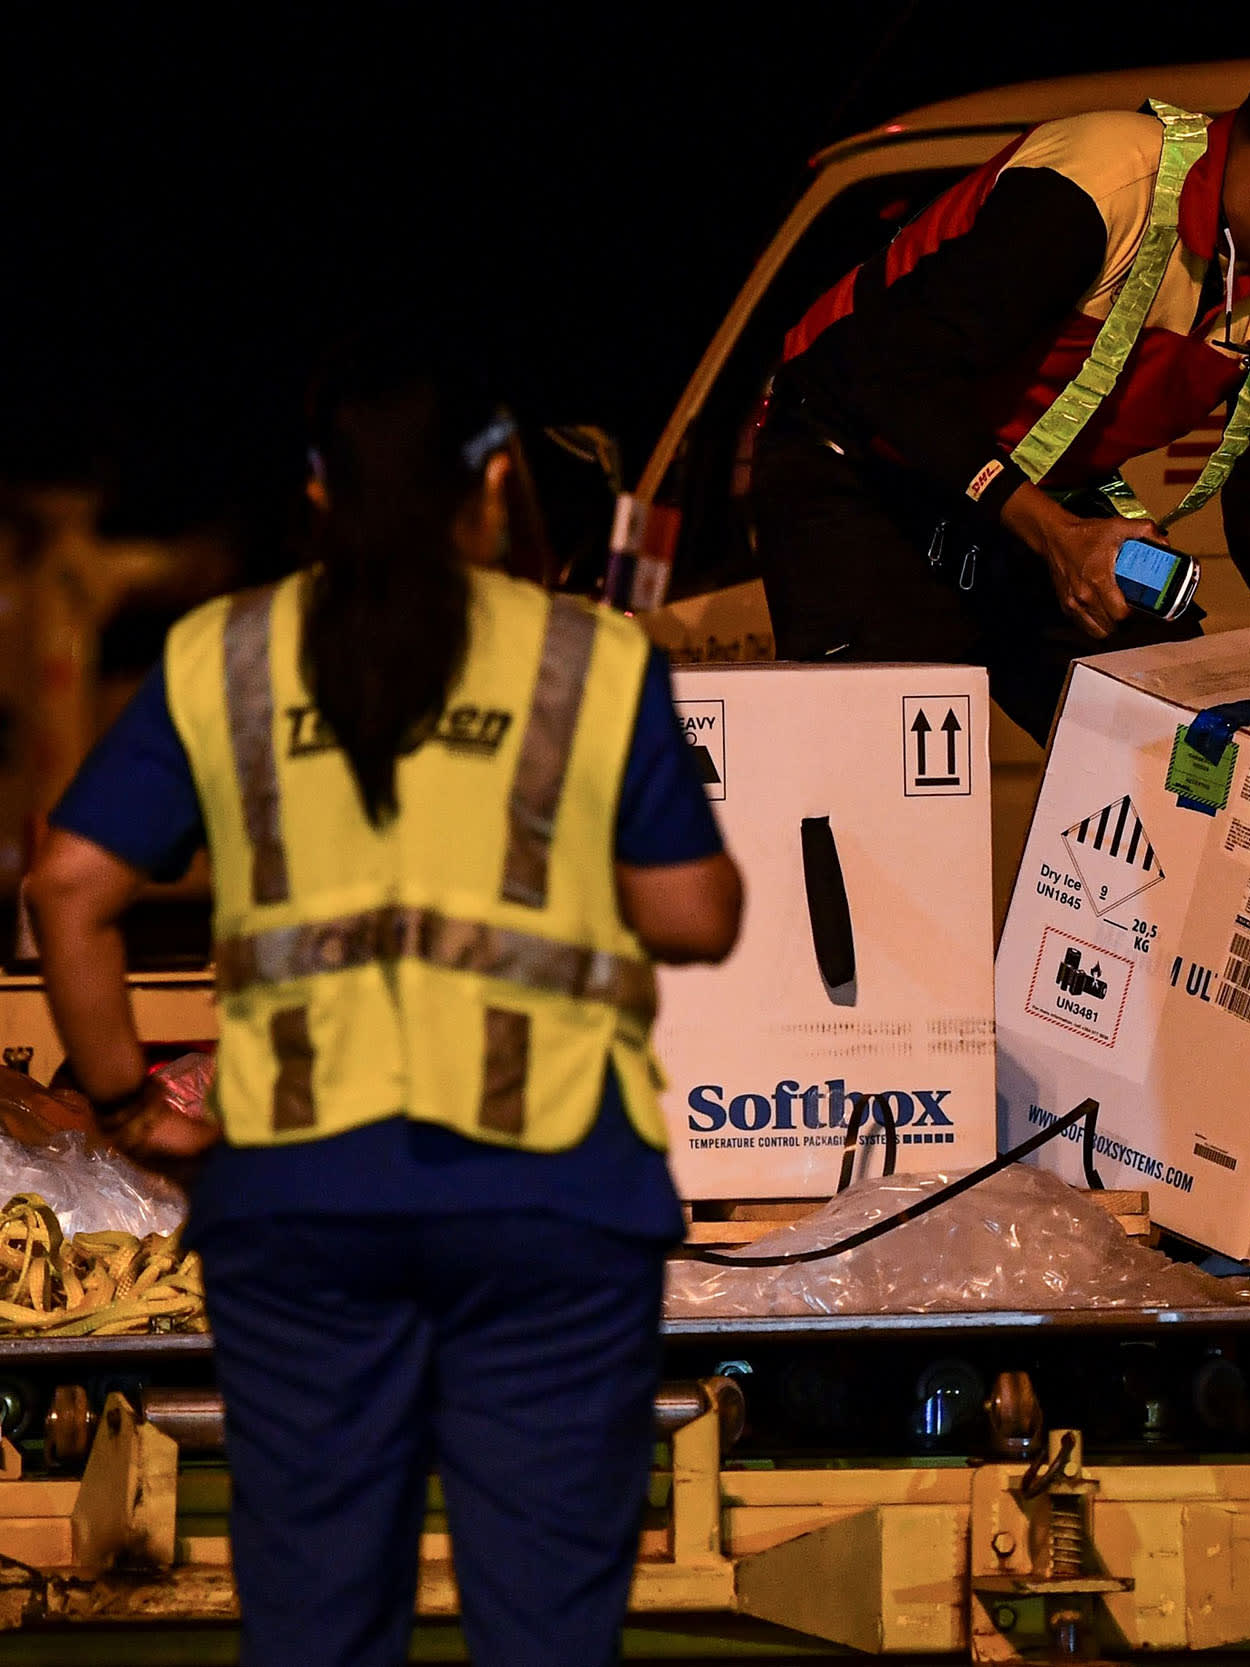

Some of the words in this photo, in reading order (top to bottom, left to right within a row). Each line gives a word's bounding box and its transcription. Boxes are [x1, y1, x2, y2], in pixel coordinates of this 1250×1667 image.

[972, 467, 996, 494] DHL
[678, 716, 716, 730] EAVY
[1040, 863, 1061, 885] Dry
[1063, 874, 1082, 891] Ice
[1036, 881, 1082, 910] UN1845
[1100, 885, 1108, 898] 9
[1132, 918, 1158, 938] 20,5
[1133, 936, 1150, 953] KG
[1056, 995, 1099, 1023] UN3481
[687, 1078, 955, 1132] Softbox
[689, 1137, 755, 1149] TEMPERATURE
[758, 1136, 800, 1148] CONTROL
[803, 1135, 848, 1147] PACKAGI
[859, 1134, 900, 1145] SYSTES
[1028, 1104, 1195, 1193] WWWOFOXSYSTEMS.COM
